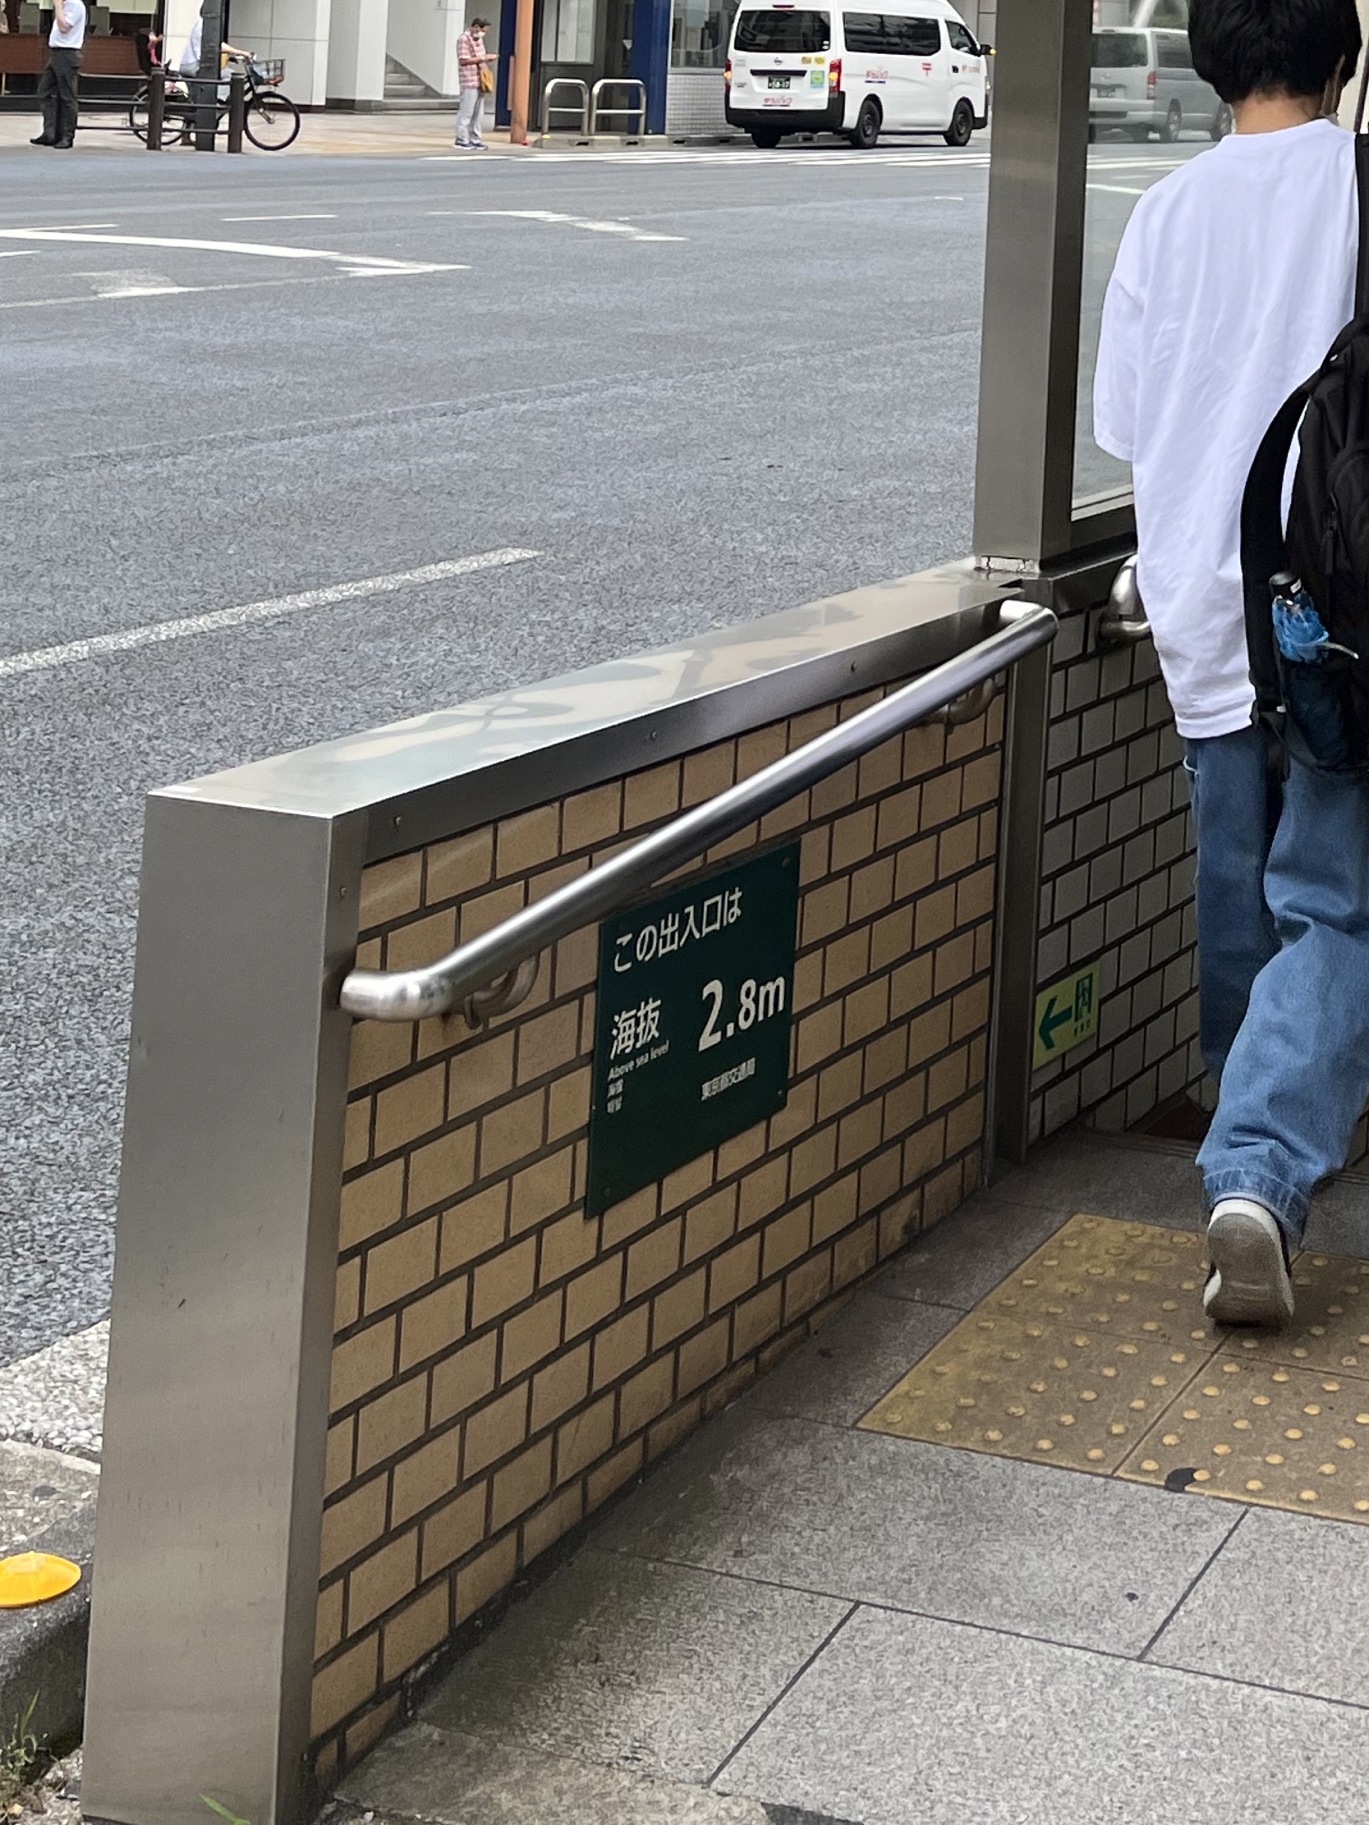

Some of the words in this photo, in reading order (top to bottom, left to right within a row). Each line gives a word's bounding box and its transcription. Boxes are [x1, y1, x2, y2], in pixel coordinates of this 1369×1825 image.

[614, 886, 742, 973] この出入口は
[610, 997, 661, 1059] 海抜
[699, 975, 784, 1051] 2.8m
[608, 1059, 633, 1078] Above
[636, 1052, 648, 1066] sea
[651, 1040, 668, 1059] level
